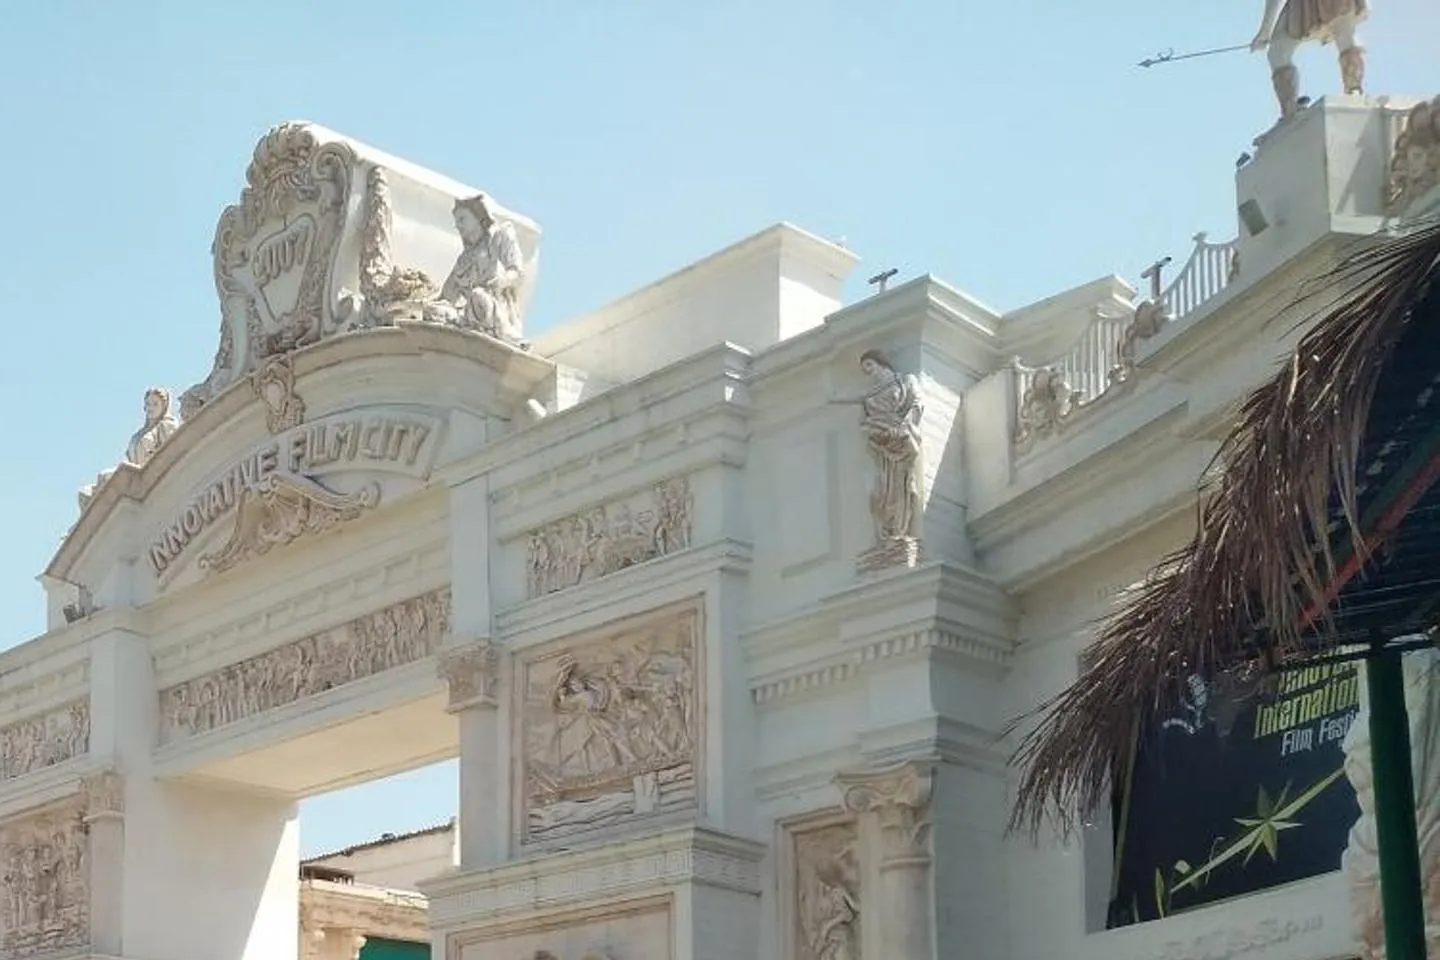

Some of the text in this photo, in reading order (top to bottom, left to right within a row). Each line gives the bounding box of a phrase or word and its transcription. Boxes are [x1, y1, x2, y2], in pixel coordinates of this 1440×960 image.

[148, 418, 431, 574] INNOVATIVE FILM CITY
[1281, 728, 1313, 756] Film
